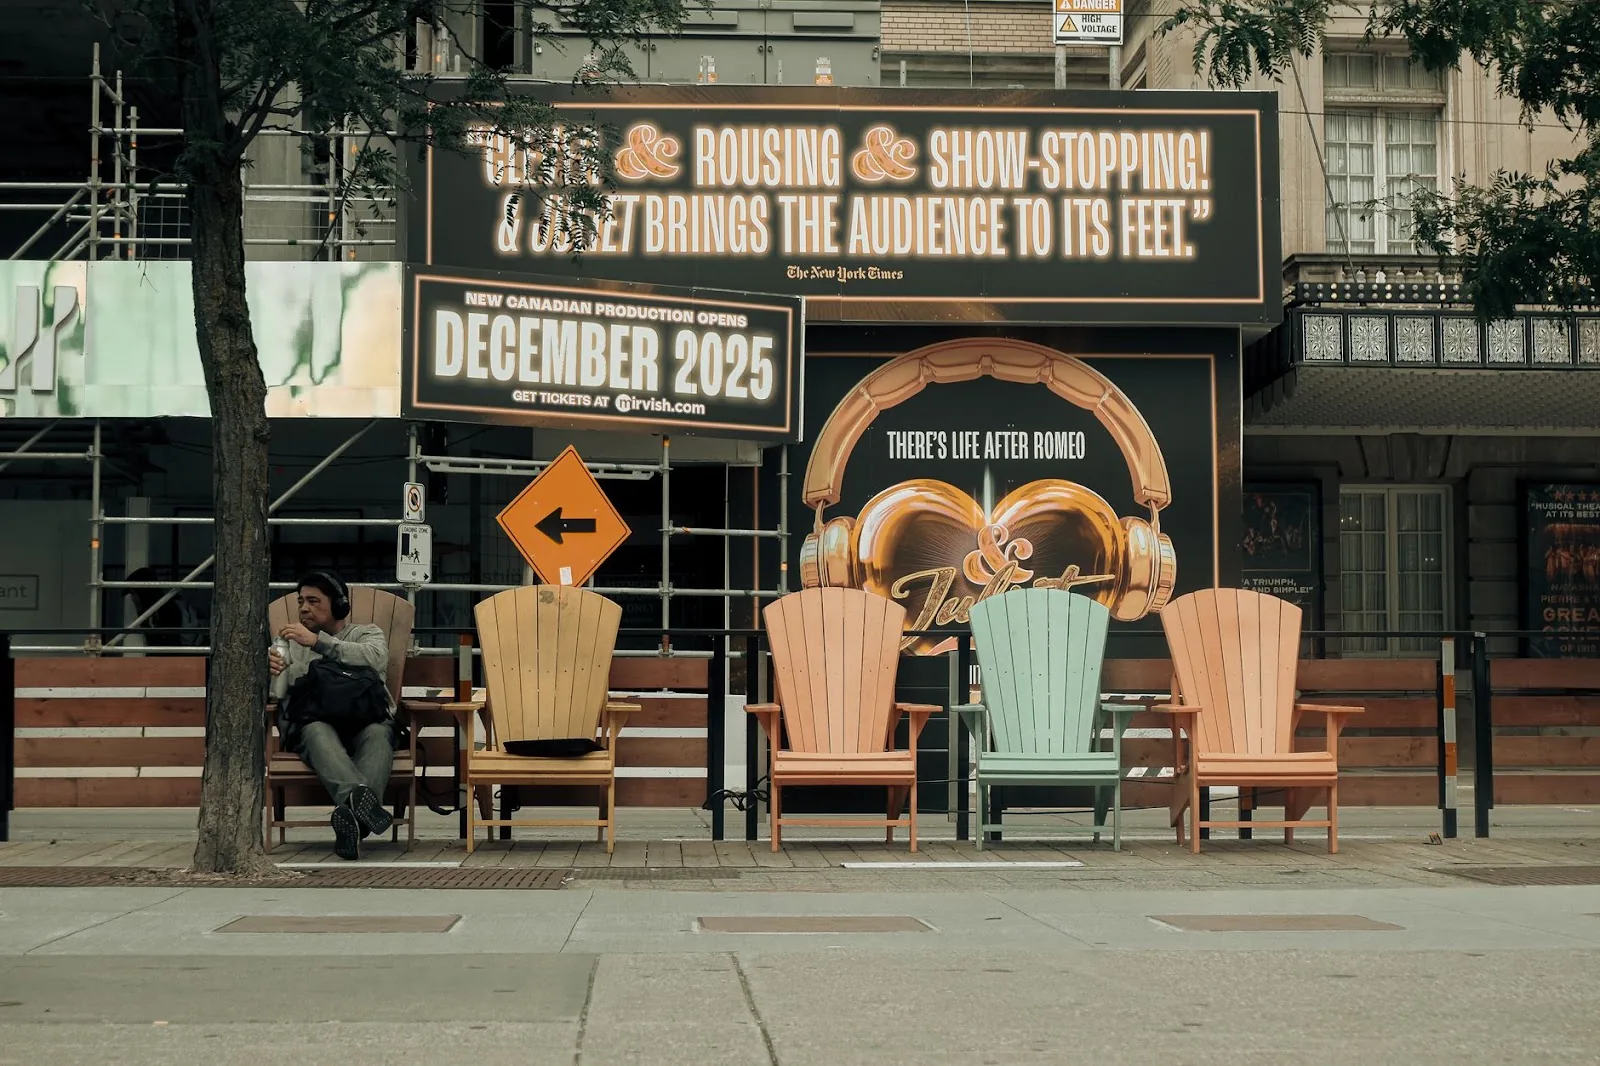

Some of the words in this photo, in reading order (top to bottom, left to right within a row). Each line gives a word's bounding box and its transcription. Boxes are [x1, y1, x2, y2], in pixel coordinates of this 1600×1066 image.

[1073, 0, 1116, 9] DANGER
[1081, 25, 1117, 33] VOLTAGE
[1082, 14, 1102, 23] HIGH
[696, 128, 839, 186] ROUSING
[930, 130, 1209, 189] SHOW-STOPPING!
[498, 194, 520, 252] &
[646, 195, 769, 253] BRINGS
[779, 196, 837, 253] THE
[849, 197, 1006, 255] AUDIENCE
[1014, 198, 1050, 255] TO
[1064, 198, 1110, 256] ITS
[787, 265, 809, 280] The
[810, 266, 836, 279] New
[837, 266, 867, 283] York
[867, 267, 904, 280] Times
[465, 291, 504, 307] NEW
[506, 295, 592, 315] CANADIAN
[595, 303, 694, 323] PRODUCTION
[697, 312, 748, 328] OPENS
[435, 310, 659, 391] DECEMBER
[674, 329, 774, 400] 2025
[512, 390, 538, 403] GET
[540, 391, 591, 407] TICKETS
[593, 395, 610, 408] AT
[615, 393, 706, 416] mirvish.com
[887, 430, 947, 460] THERE’S
[952, 431, 980, 460] LIFE
[984, 431, 1029, 460] AFTER
[1034, 431, 1086, 460] ROMEO
[1252, 578, 1297, 586] TRIUMPH,
